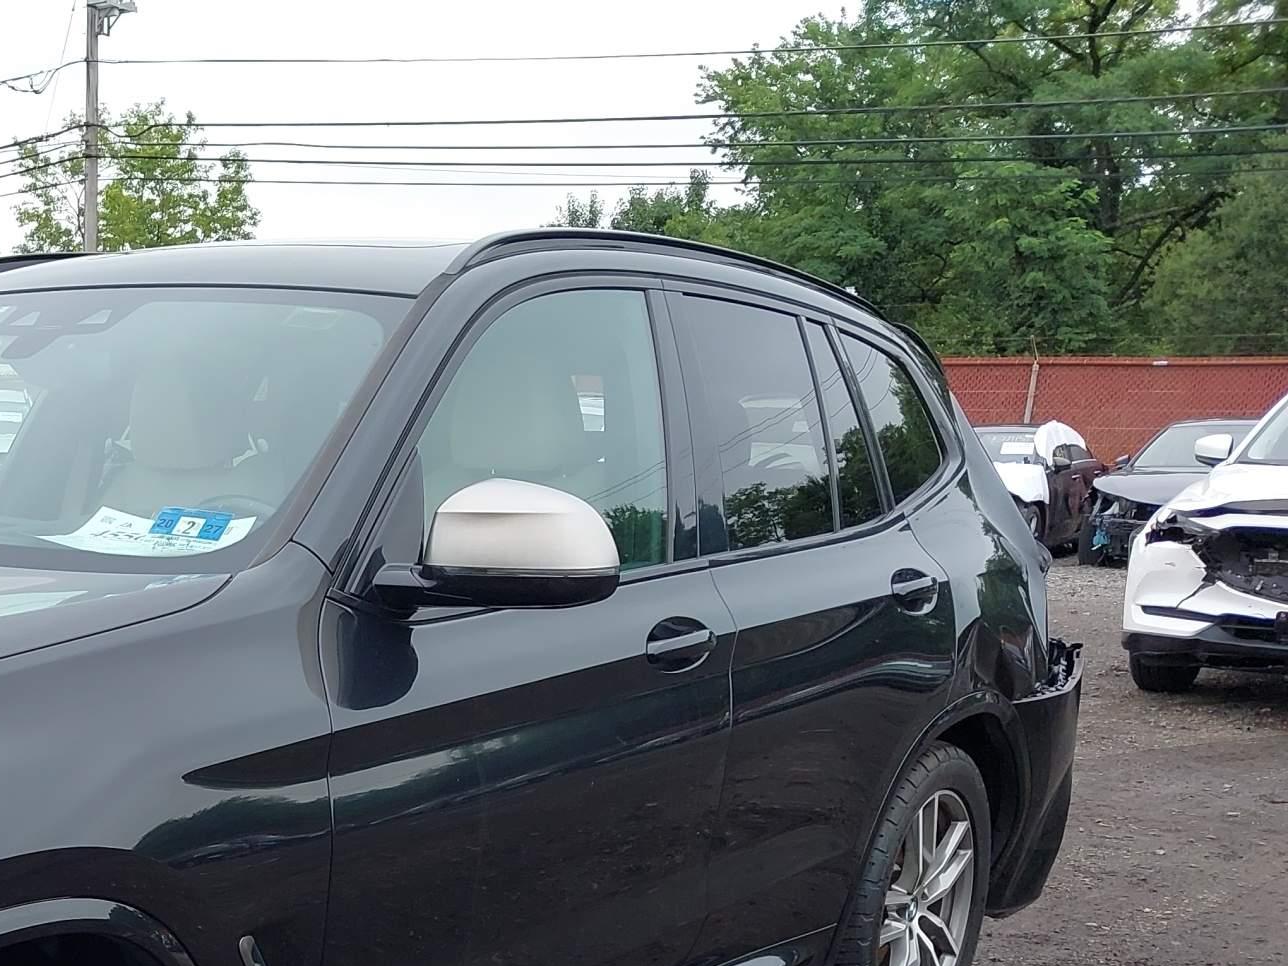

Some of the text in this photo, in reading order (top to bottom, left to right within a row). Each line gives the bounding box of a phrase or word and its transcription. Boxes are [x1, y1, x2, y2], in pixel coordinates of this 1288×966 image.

[157, 518, 223, 535] 20 2 27
